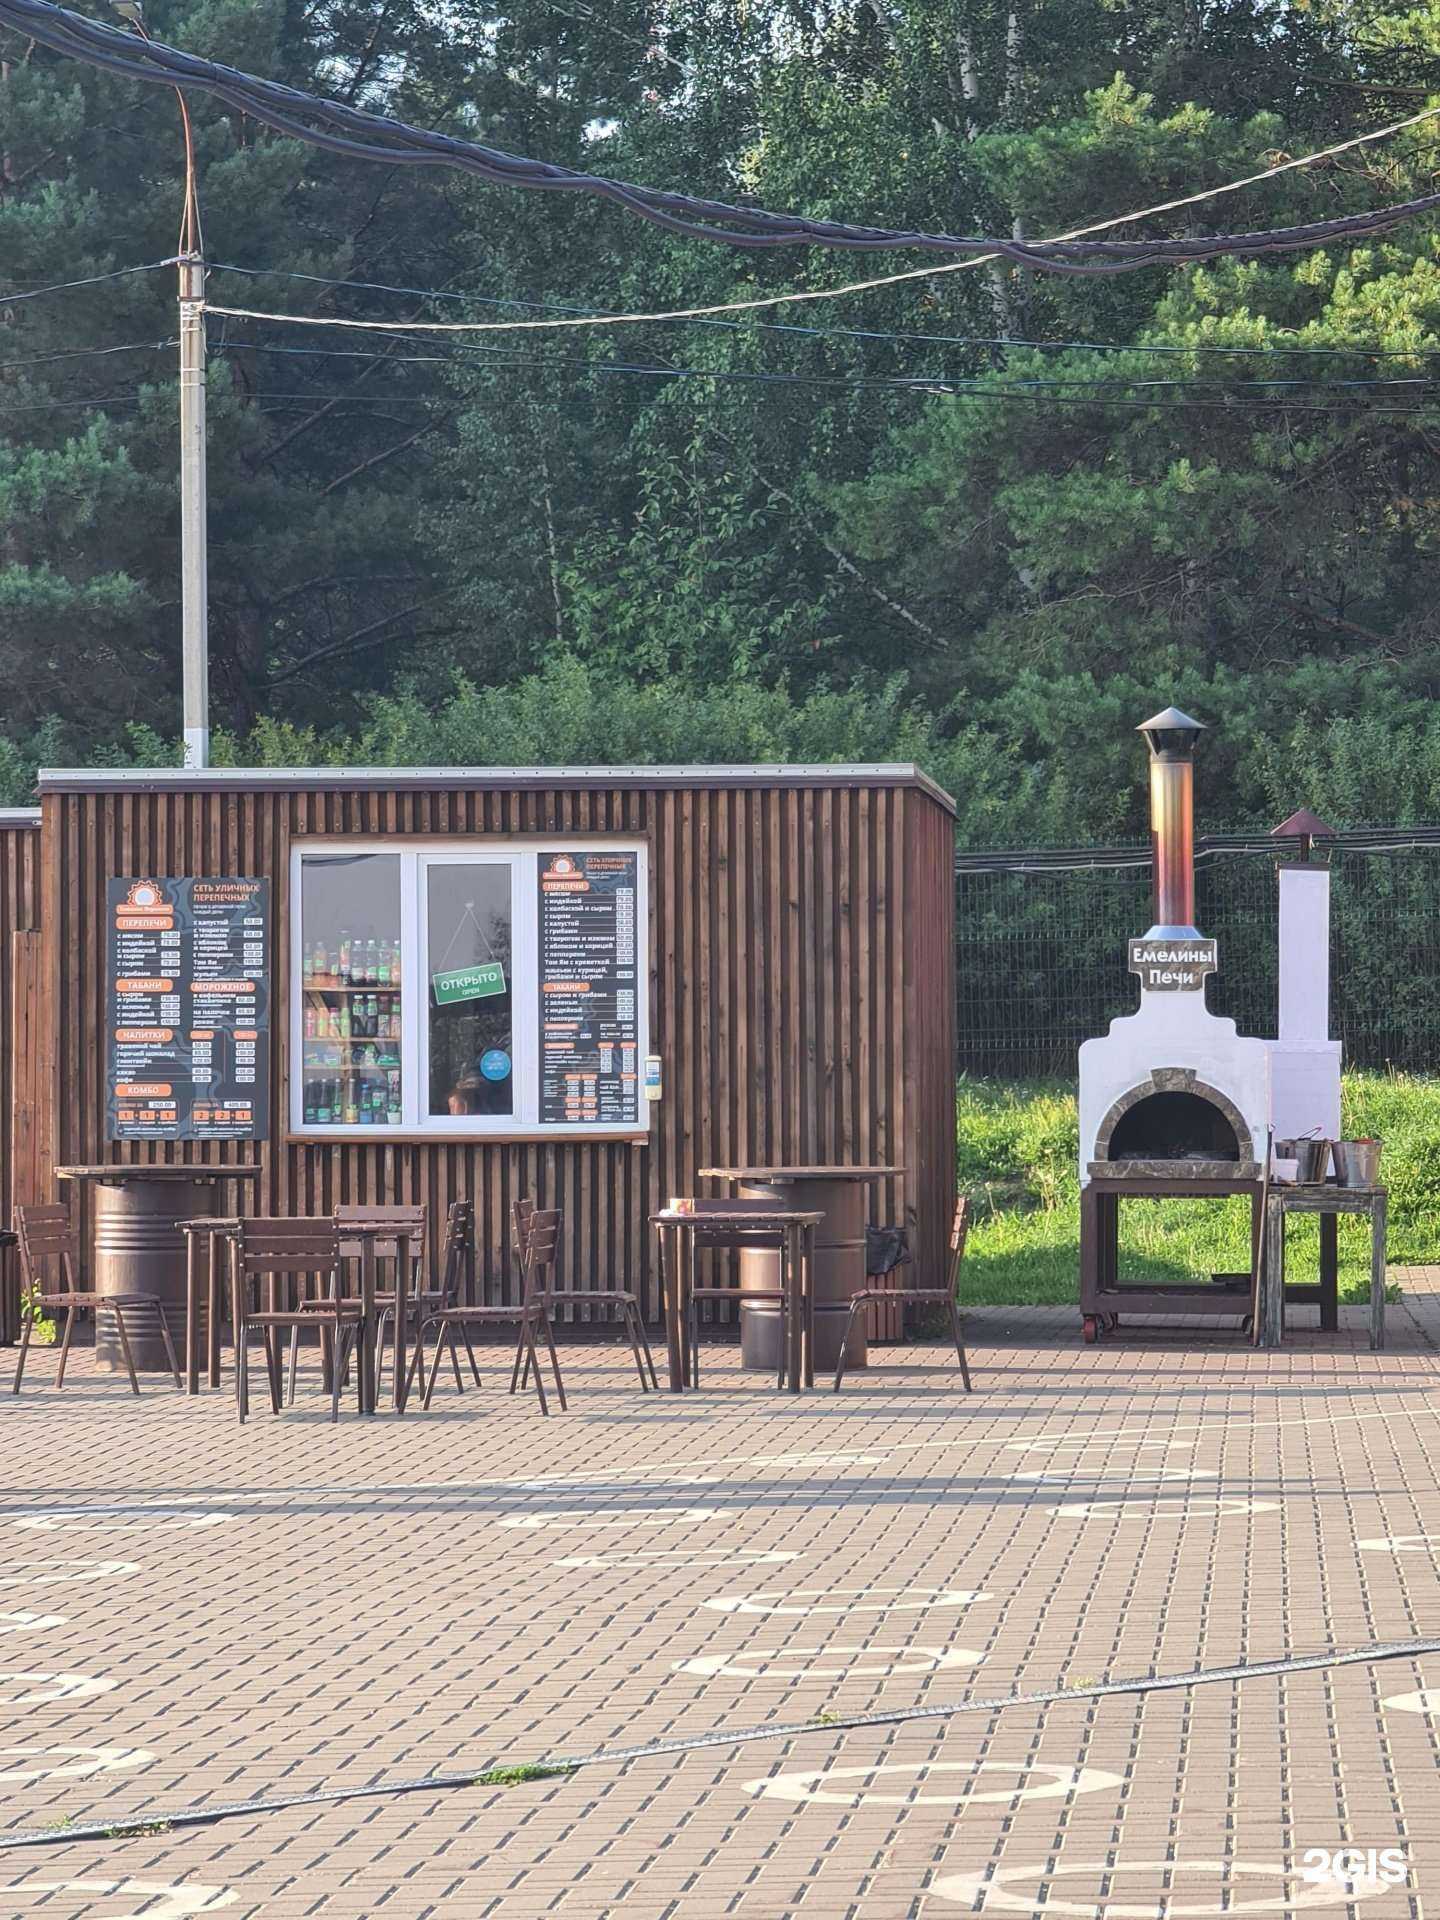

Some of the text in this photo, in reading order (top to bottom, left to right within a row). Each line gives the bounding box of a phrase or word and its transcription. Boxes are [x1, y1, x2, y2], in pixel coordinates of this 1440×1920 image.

[193, 884, 260, 892] СЕТЬ УЛИЧНЫХ
[1133, 948, 1212, 962] Емелины
[441, 972, 497, 991] ОТКРЫТО
[1150, 970, 1193, 984] Печи
[194, 983, 250, 991] МОРОЖЕНОЕ
[123, 1031, 165, 1039] НАПИТКИ
